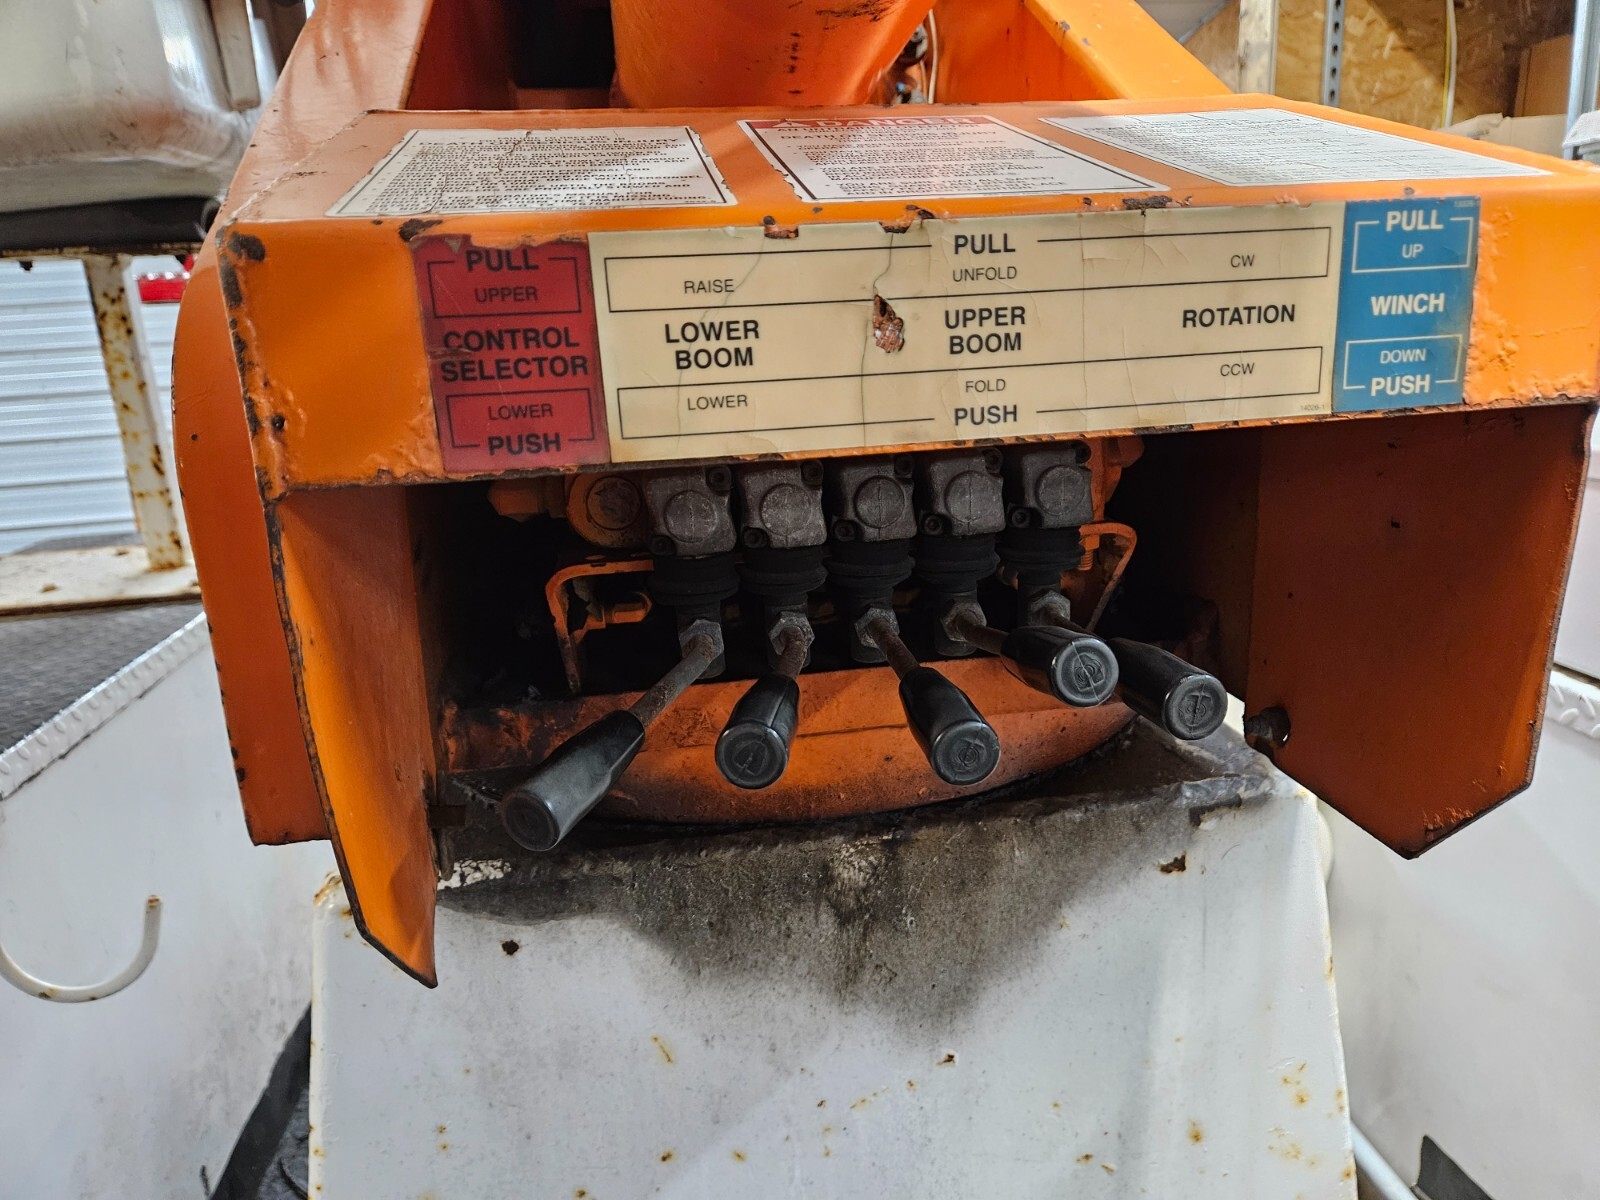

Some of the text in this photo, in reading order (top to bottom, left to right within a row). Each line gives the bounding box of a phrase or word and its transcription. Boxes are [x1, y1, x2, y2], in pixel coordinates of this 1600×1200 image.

[816, 118, 976, 127] DANGER
[1386, 210, 1444, 232] PULL
[954, 233, 1016, 255] PULL
[1401, 243, 1424, 259] UP
[466, 249, 539, 272] PULL
[1230, 254, 1255, 268] CW
[952, 266, 1018, 282] UNFOLD
[475, 286, 538, 302] UPPER
[684, 278, 735, 294] RAISE
[1370, 293, 1446, 316] WINCH
[945, 306, 1026, 329] UPPER
[1182, 304, 1296, 328] ROTATION
[443, 327, 580, 352] CONTROL
[665, 319, 760, 344] LOWER
[949, 332, 1022, 354] BOOM
[675, 347, 754, 370] BOOM
[1380, 348, 1426, 364] DOWN
[441, 355, 588, 382] SELECTOR
[1220, 362, 1255, 377] CCW
[965, 379, 1006, 394] FOLD
[1370, 374, 1431, 397] PUSH
[488, 403, 554, 420] LOWER
[687, 394, 748, 411] LOWER
[954, 404, 1018, 426] PUSH
[488, 433, 561, 456] PUSH
